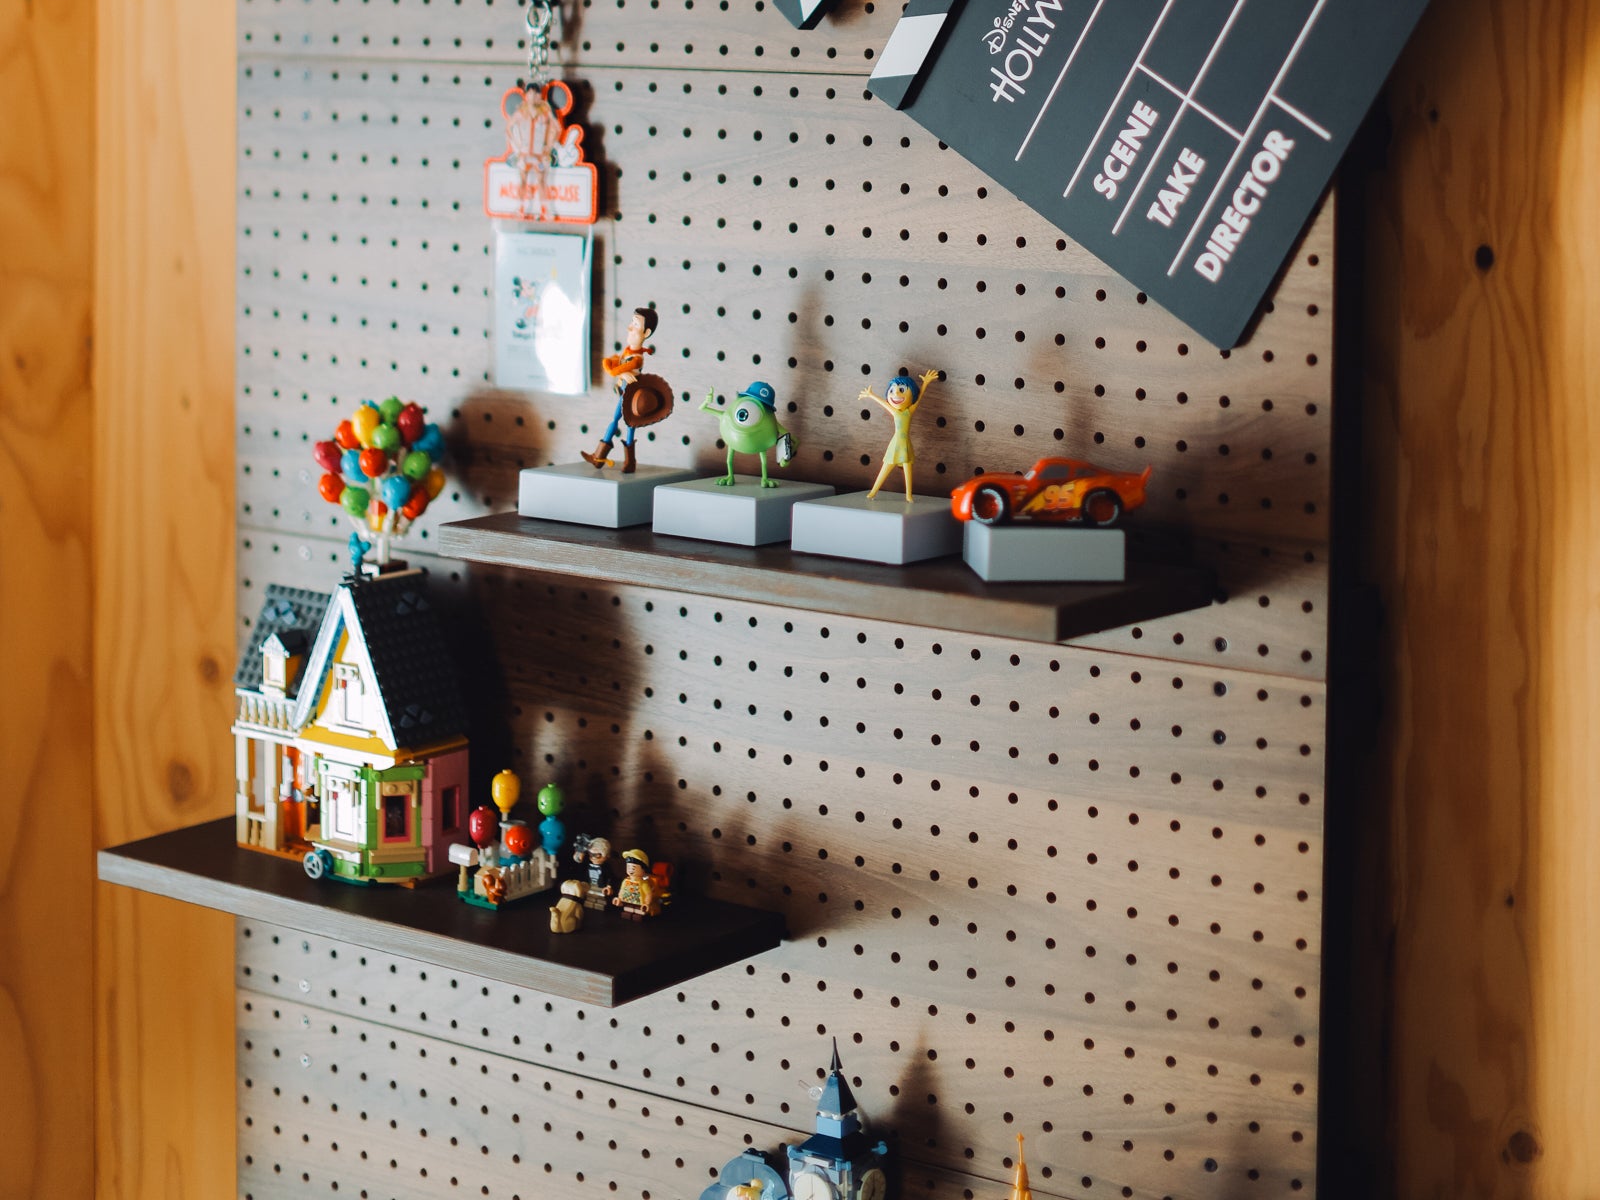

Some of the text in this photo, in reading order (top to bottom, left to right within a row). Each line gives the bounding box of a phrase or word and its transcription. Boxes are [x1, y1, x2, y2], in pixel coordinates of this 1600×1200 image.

[1092, 99, 1160, 202] SCENE
[1145, 146, 1207, 228] TAKE
[1193, 129, 1296, 283] DIRECTOR
[1044, 482, 1075, 510] 95
